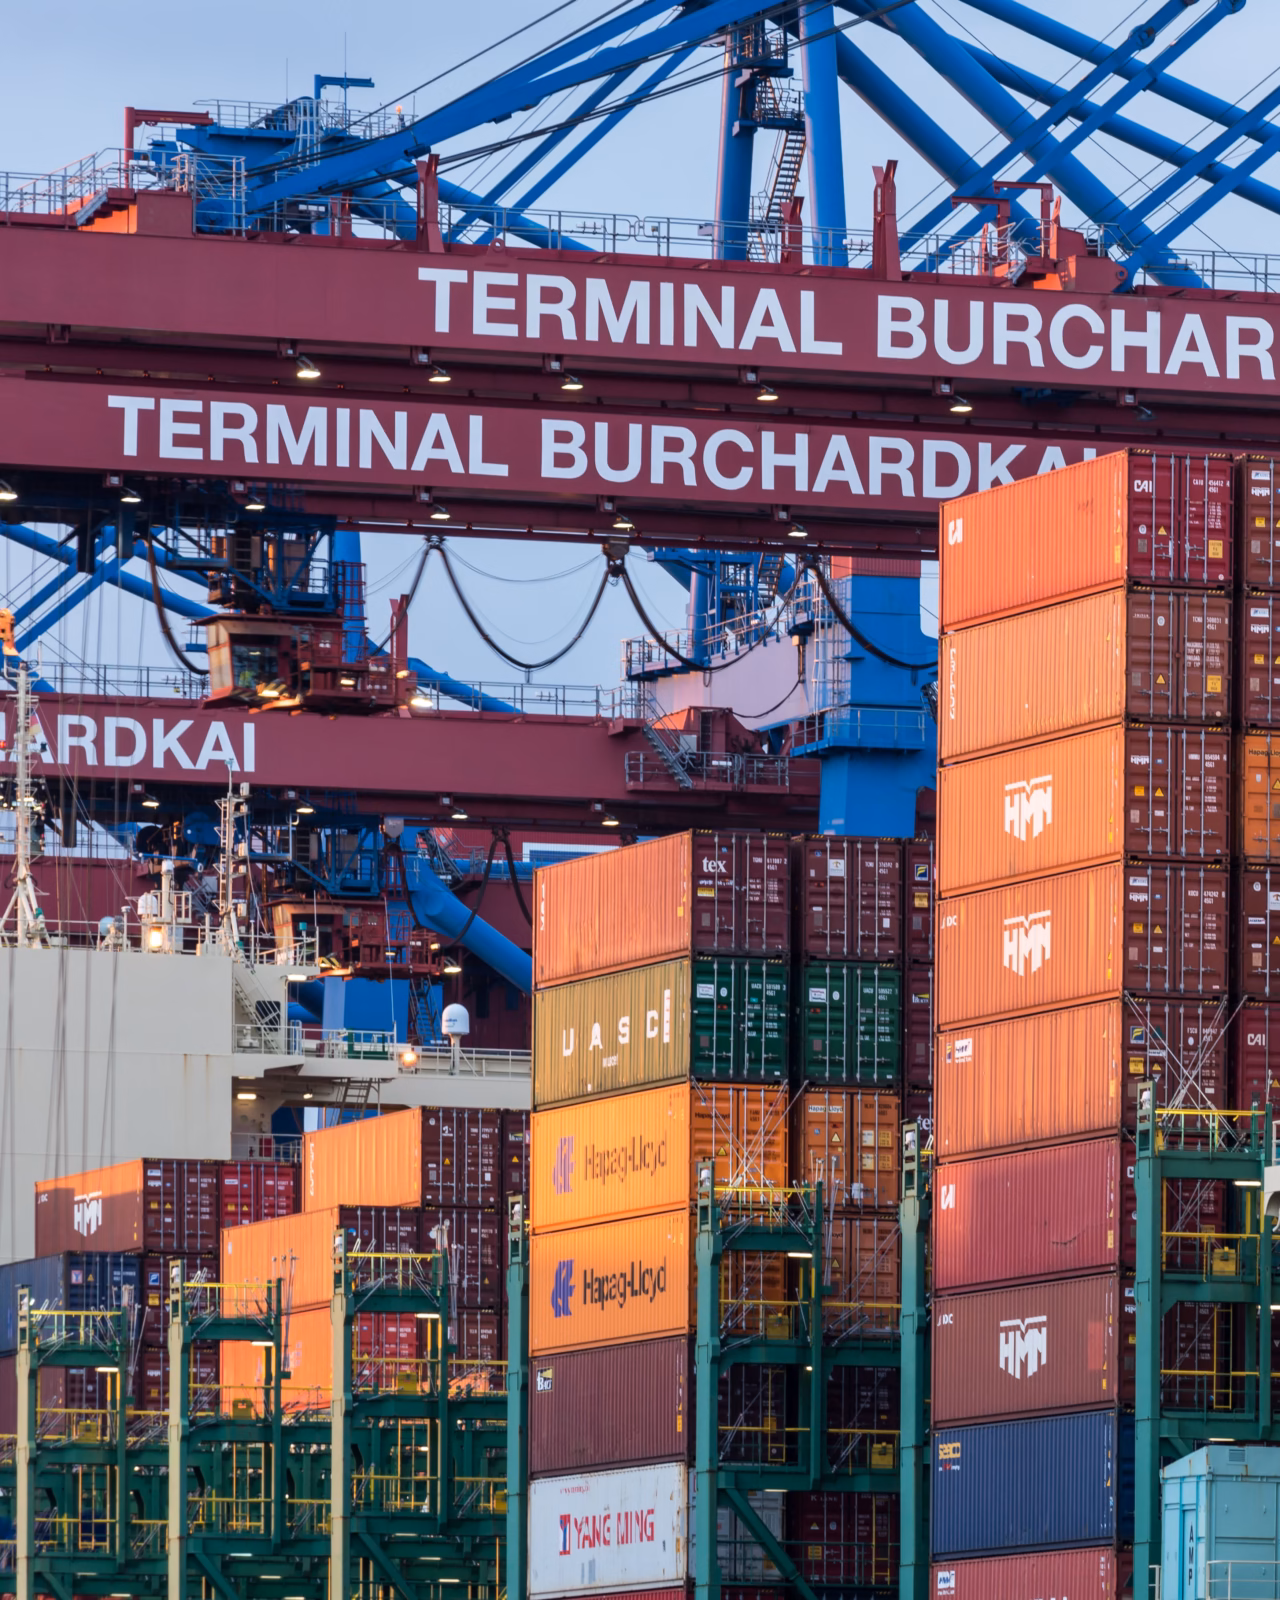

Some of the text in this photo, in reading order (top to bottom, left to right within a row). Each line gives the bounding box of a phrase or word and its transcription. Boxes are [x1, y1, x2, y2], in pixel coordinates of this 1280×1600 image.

[418, 267, 843, 356] TERMINAL
[107, 394, 1097, 499] TERMINAL BURCHARDK
[1134, 480, 1152, 492] CAI
[1251, 487, 1270, 497] HMM
[0, 713, 256, 773] ARDKAI
[702, 856, 726, 873] tex
[562, 1010, 659, 1057] UASC
[1248, 1034, 1266, 1046] CAI
[808, 1105, 844, 1114] HapagLloyd
[583, 1255, 666, 1311] Hapag-Lloyd
[574, 1509, 655, 1550] YANG MING
